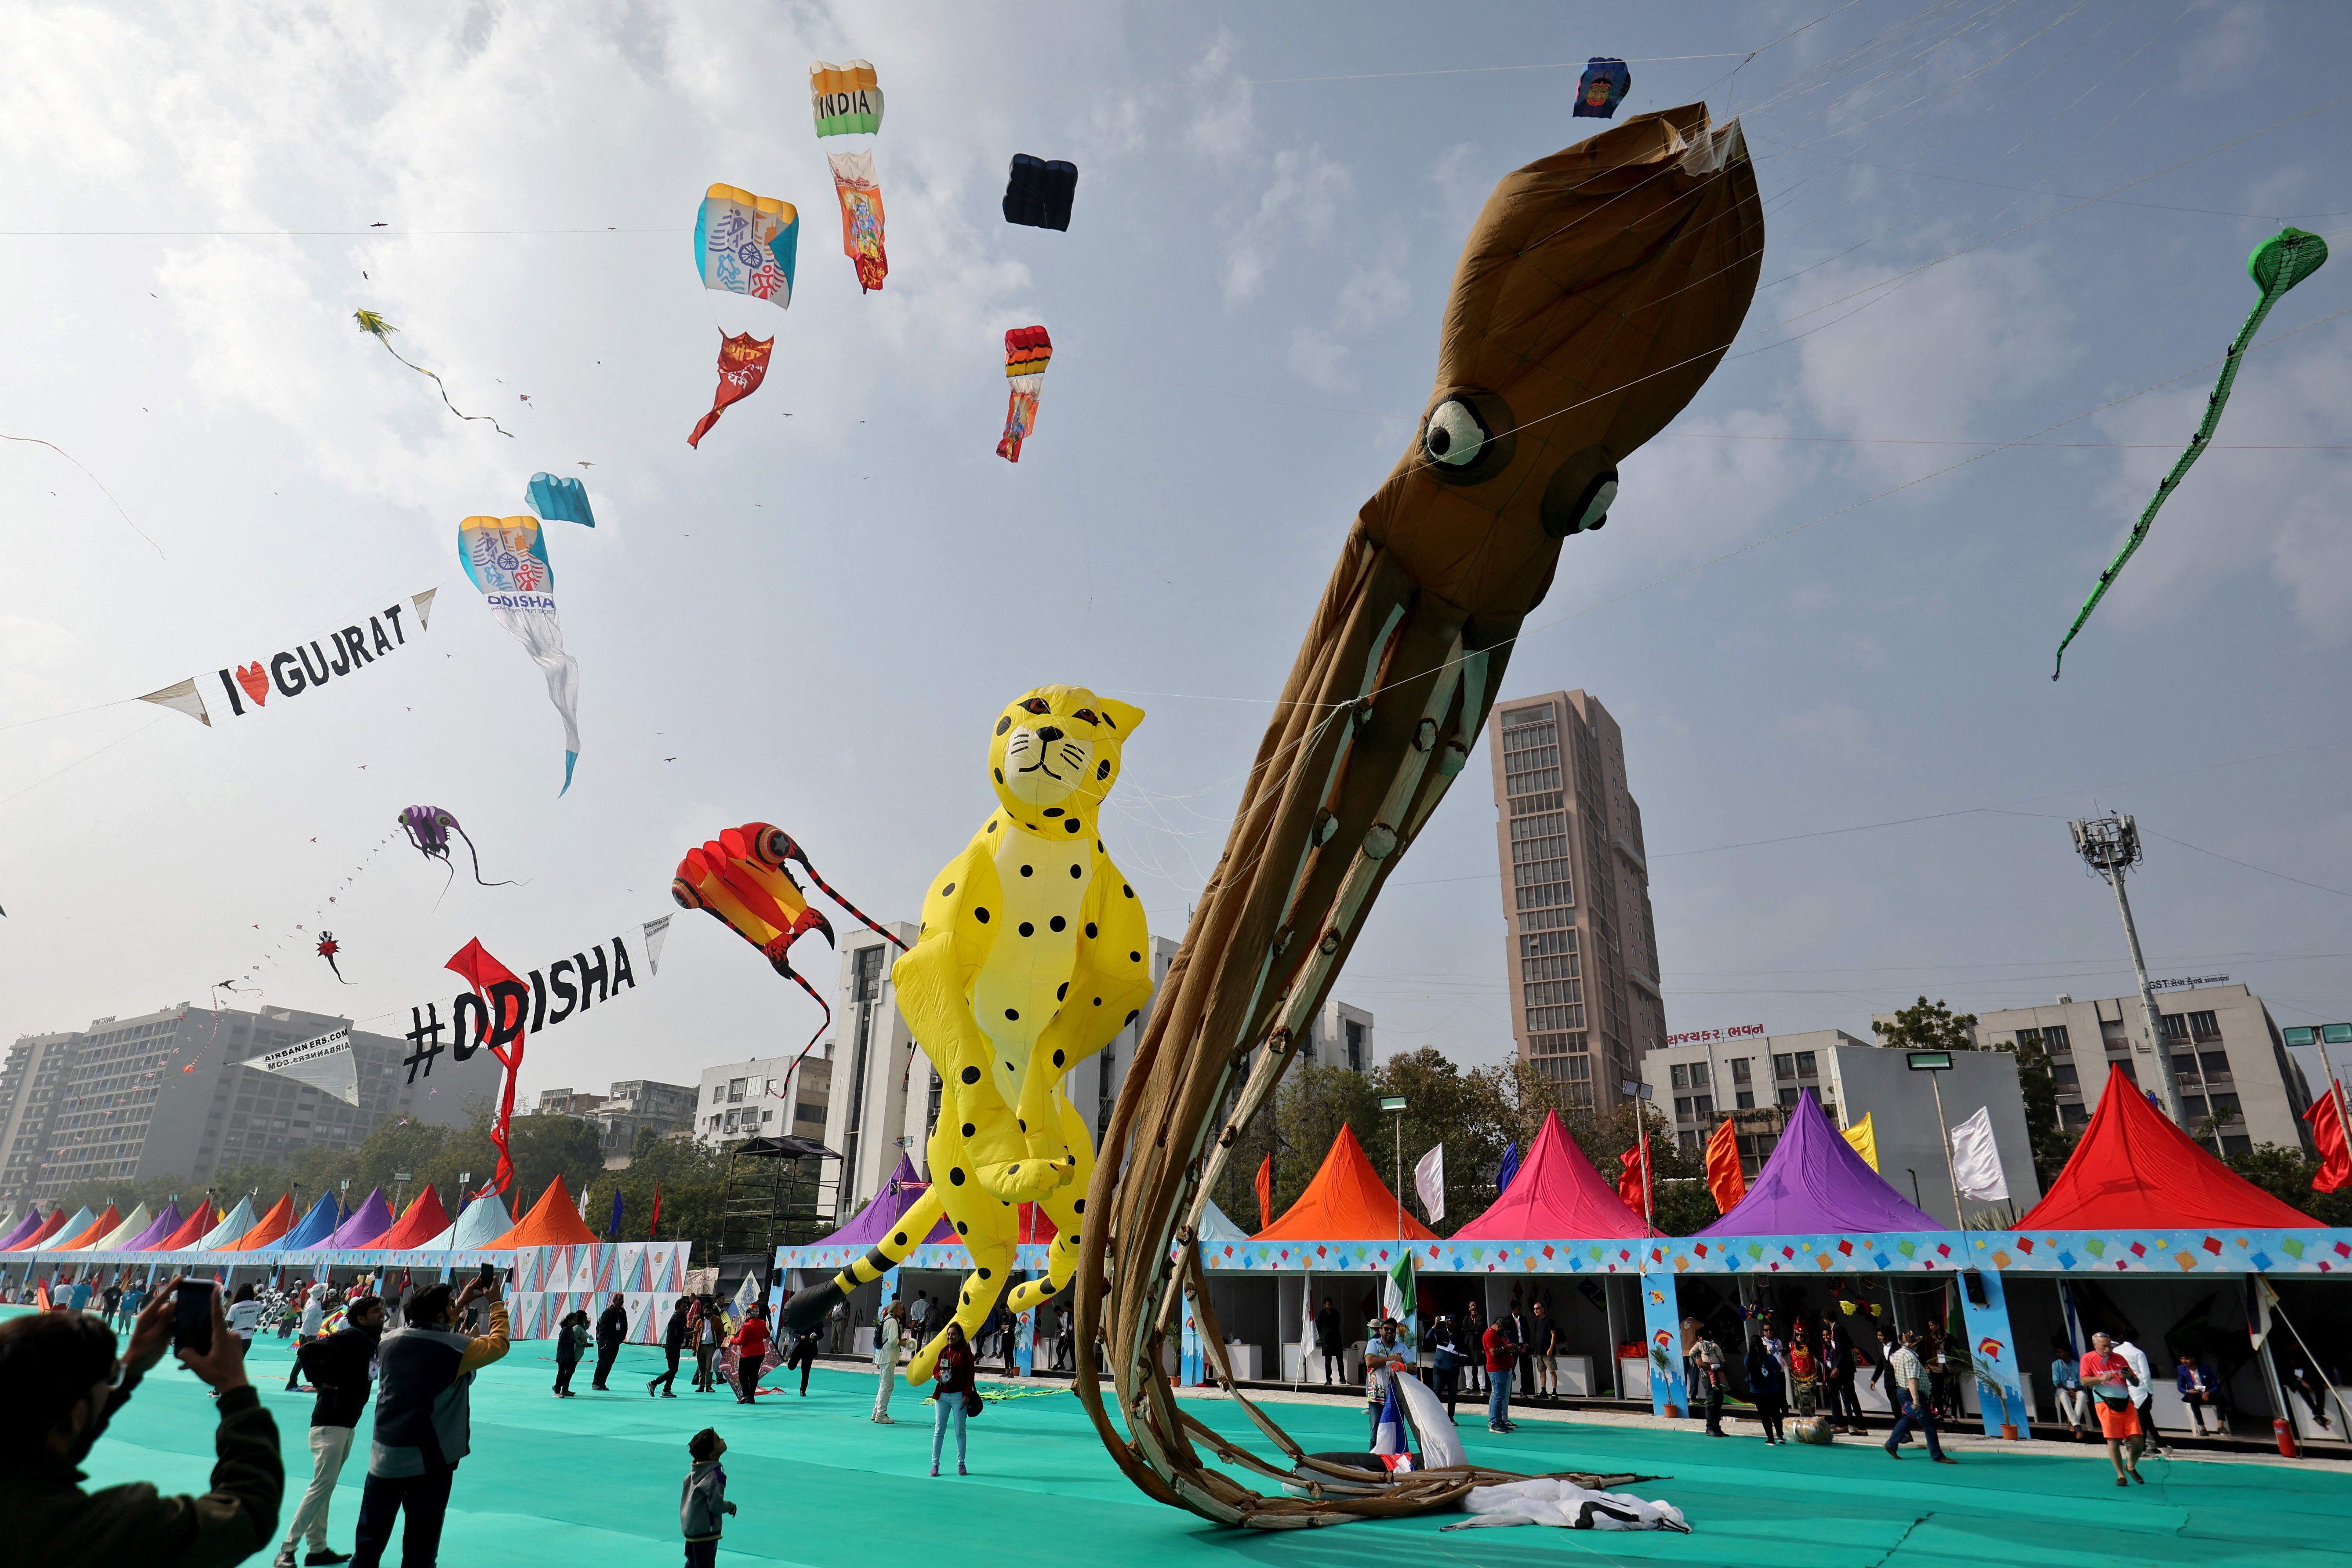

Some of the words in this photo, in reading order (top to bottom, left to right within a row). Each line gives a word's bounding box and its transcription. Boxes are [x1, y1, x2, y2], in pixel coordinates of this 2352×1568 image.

[820, 89, 871, 119] INDIA
[488, 595, 555, 608] ODISHA
[219, 669, 247, 716] I
[270, 604, 406, 697] GUJRAT
[2149, 980, 2169, 989] GST
[403, 936, 636, 1085] #ODISHA
[264, 1029, 348, 1061] AIRBANNERS.COM
[1728, 1024, 1764, 1037] ભવન
